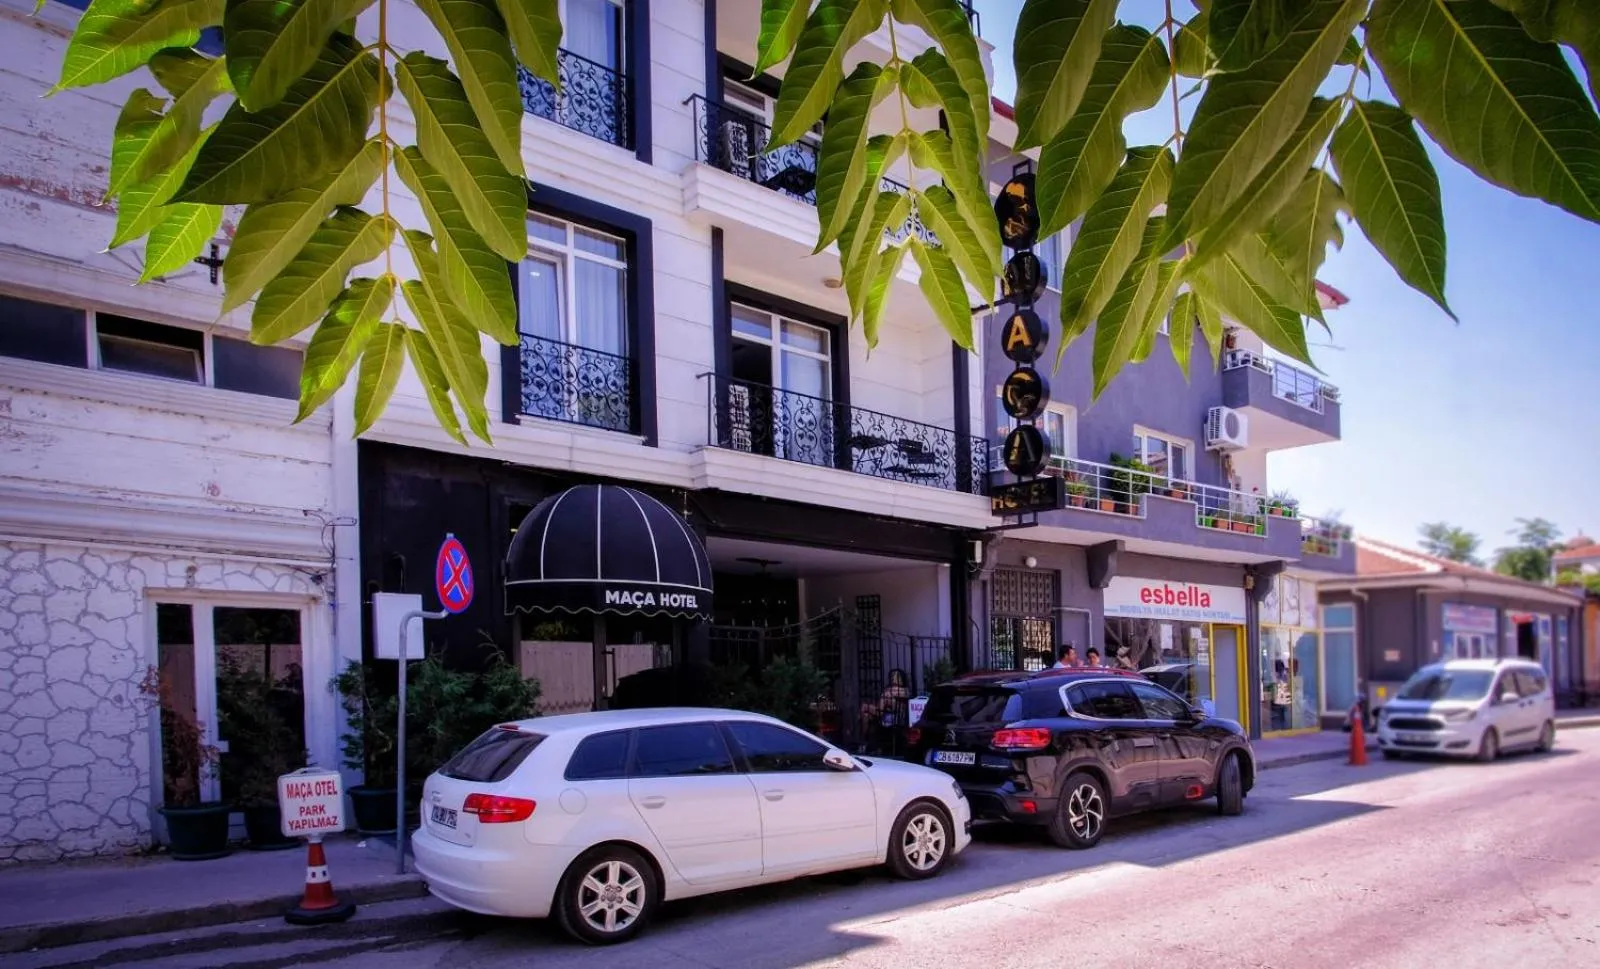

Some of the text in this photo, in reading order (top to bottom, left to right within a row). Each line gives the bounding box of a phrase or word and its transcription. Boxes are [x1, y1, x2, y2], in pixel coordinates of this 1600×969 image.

[605, 590, 698, 608] MAÇA HOTEL
[1140, 583, 1211, 608] esbella
[286, 780, 338, 800] MAÇA OTEL
[299, 804, 326, 816] PARK
[288, 816, 339, 830] YAPILMAZ
